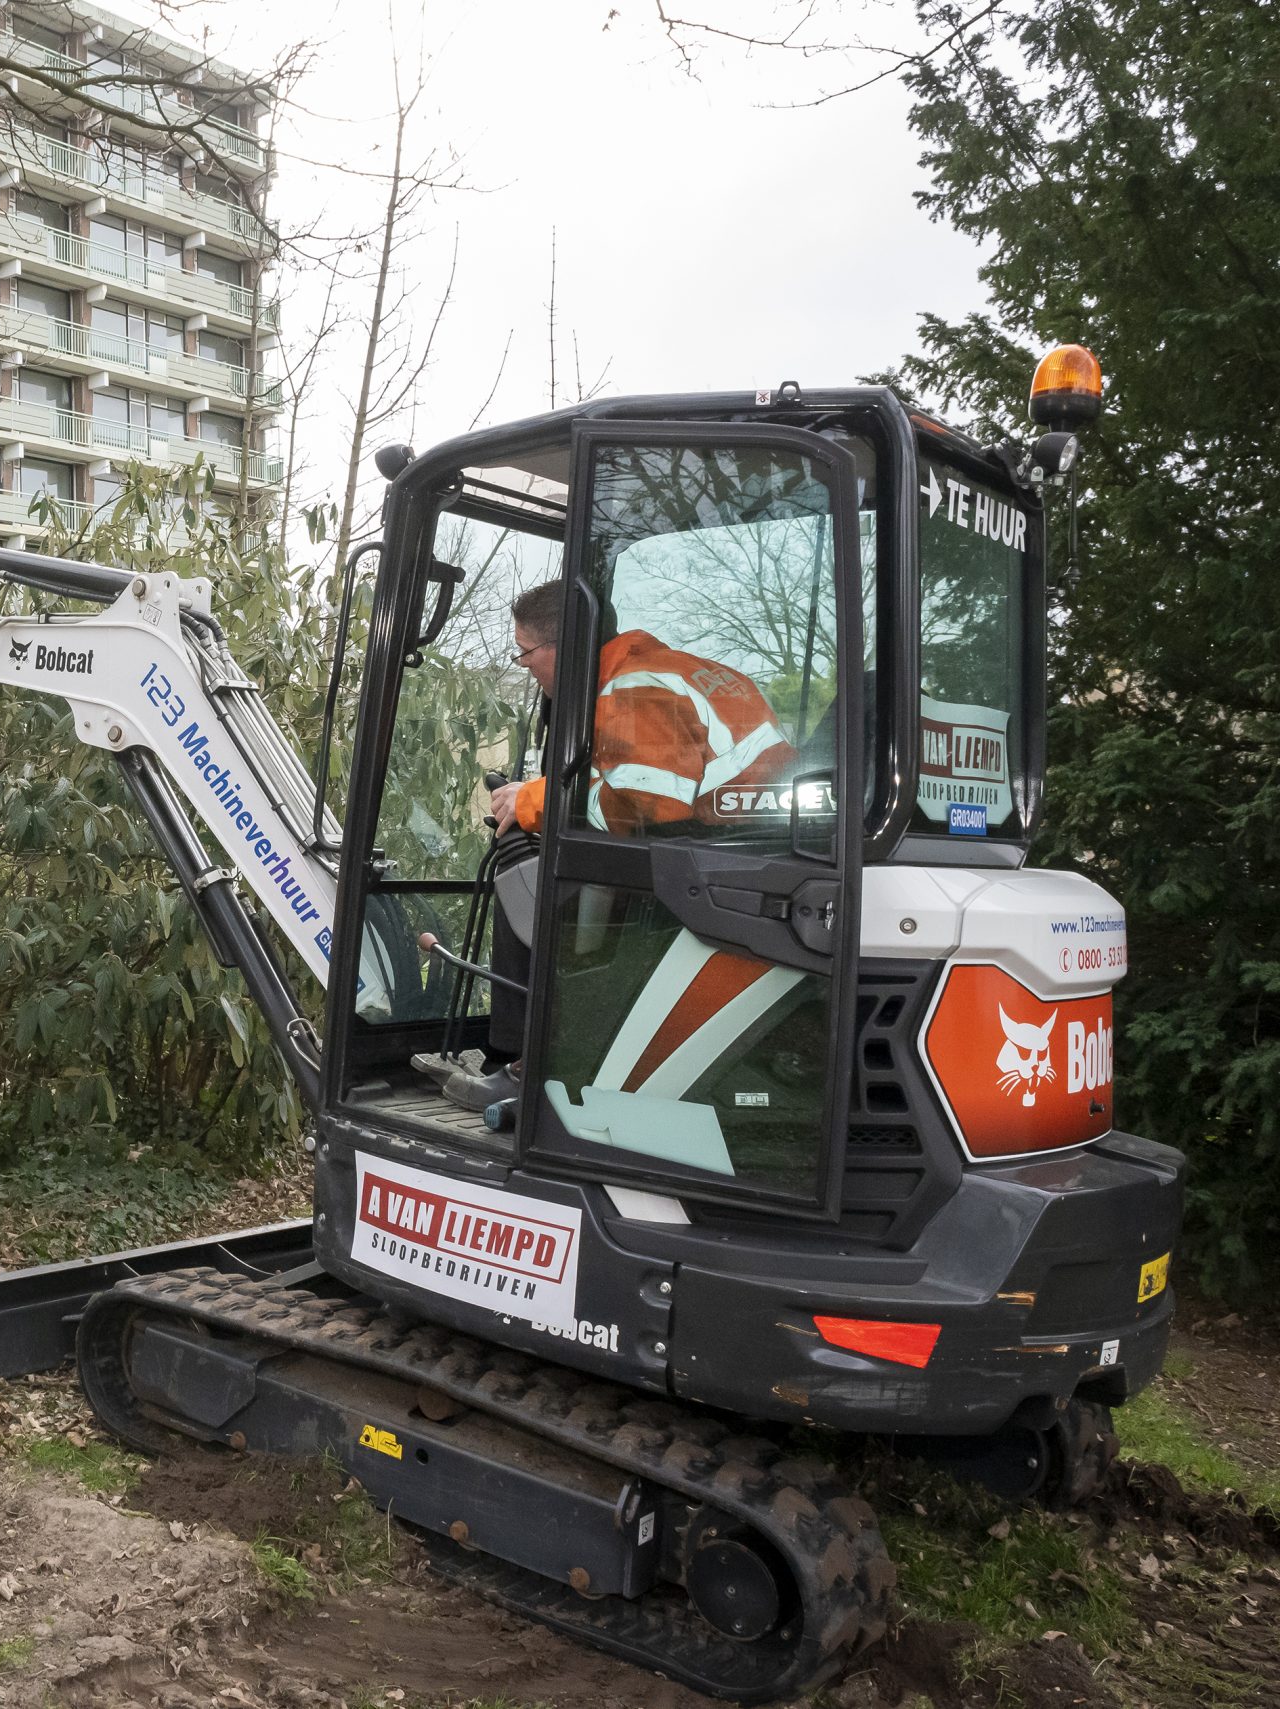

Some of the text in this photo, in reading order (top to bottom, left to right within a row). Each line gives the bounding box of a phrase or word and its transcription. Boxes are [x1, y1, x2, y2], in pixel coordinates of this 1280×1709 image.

[947, 478, 1027, 552] TE HUUR
[35, 645, 93, 674] Bobcat
[923, 729, 1001, 772] VAN LIEMPD
[177, 721, 320, 923] Machineverhuur
[951, 808, 986, 829] GR034001
[1077, 948, 1101, 970] 0800
[367, 1185, 557, 1268] A VAN LIEMPD
[372, 1232, 536, 1300] SLOOPBEDRIJVEN
